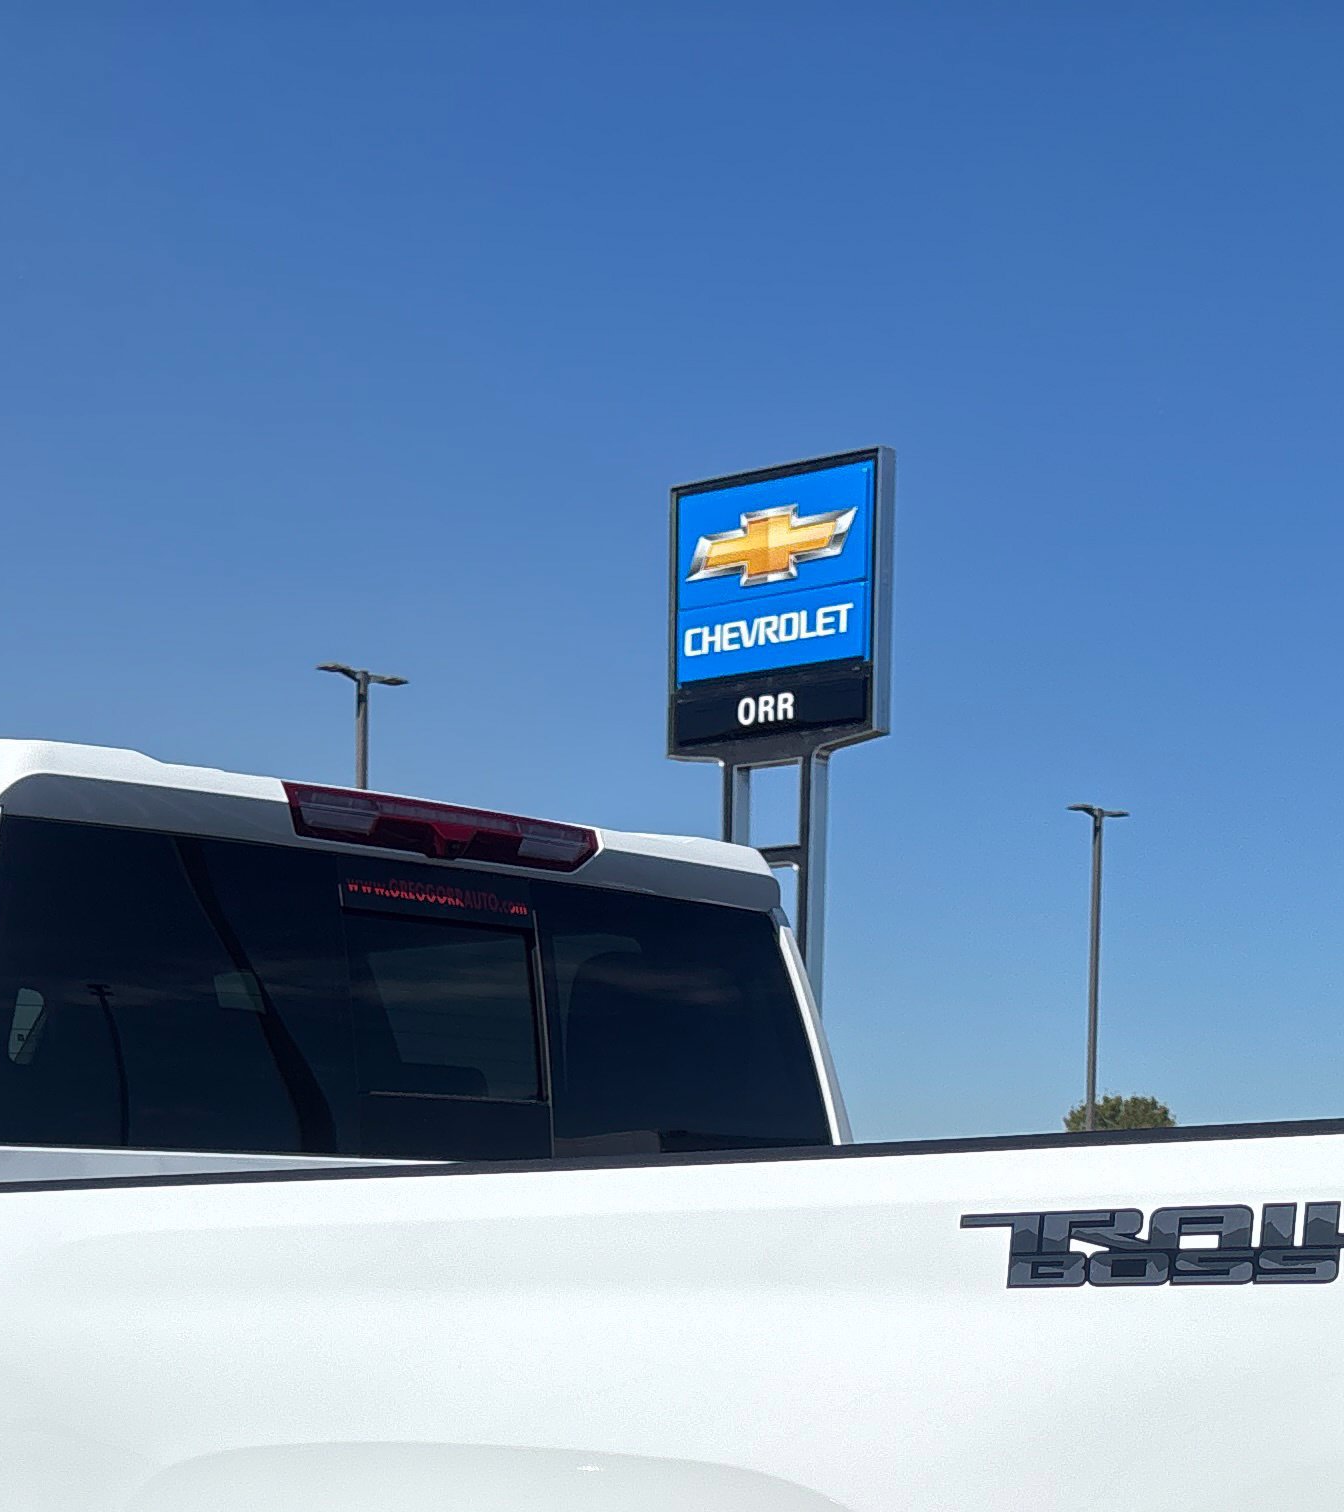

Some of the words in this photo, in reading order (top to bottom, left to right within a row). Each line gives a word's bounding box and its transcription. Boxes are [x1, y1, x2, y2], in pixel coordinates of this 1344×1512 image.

[683, 602, 855, 657] CHEVROLET
[737, 691, 795, 725] ORR
[1006, 1248, 1341, 1289] BOSS
